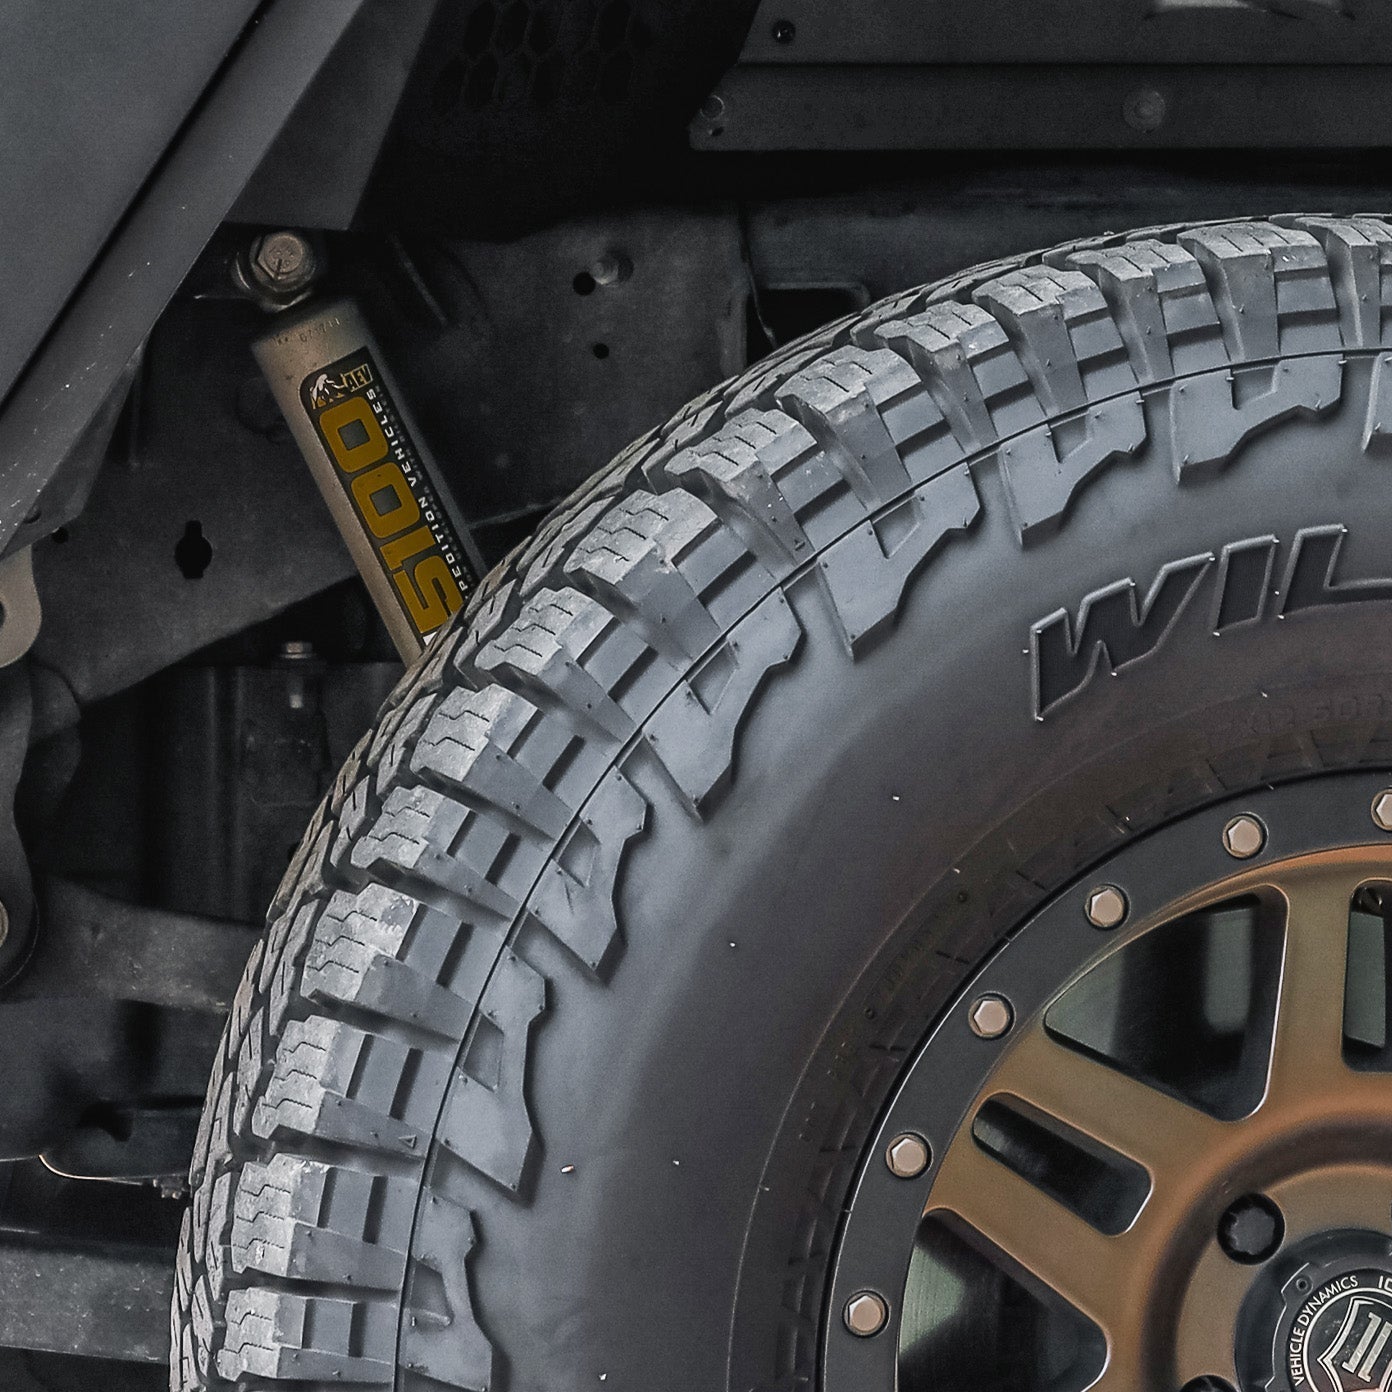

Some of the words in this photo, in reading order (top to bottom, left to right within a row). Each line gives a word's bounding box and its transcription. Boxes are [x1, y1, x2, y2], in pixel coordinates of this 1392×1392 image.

[366, 388, 417, 487] VEHICLES
[1289, 1327, 1304, 1387] VEHICLE
[1299, 1274, 1359, 1329] DYNAMICS
